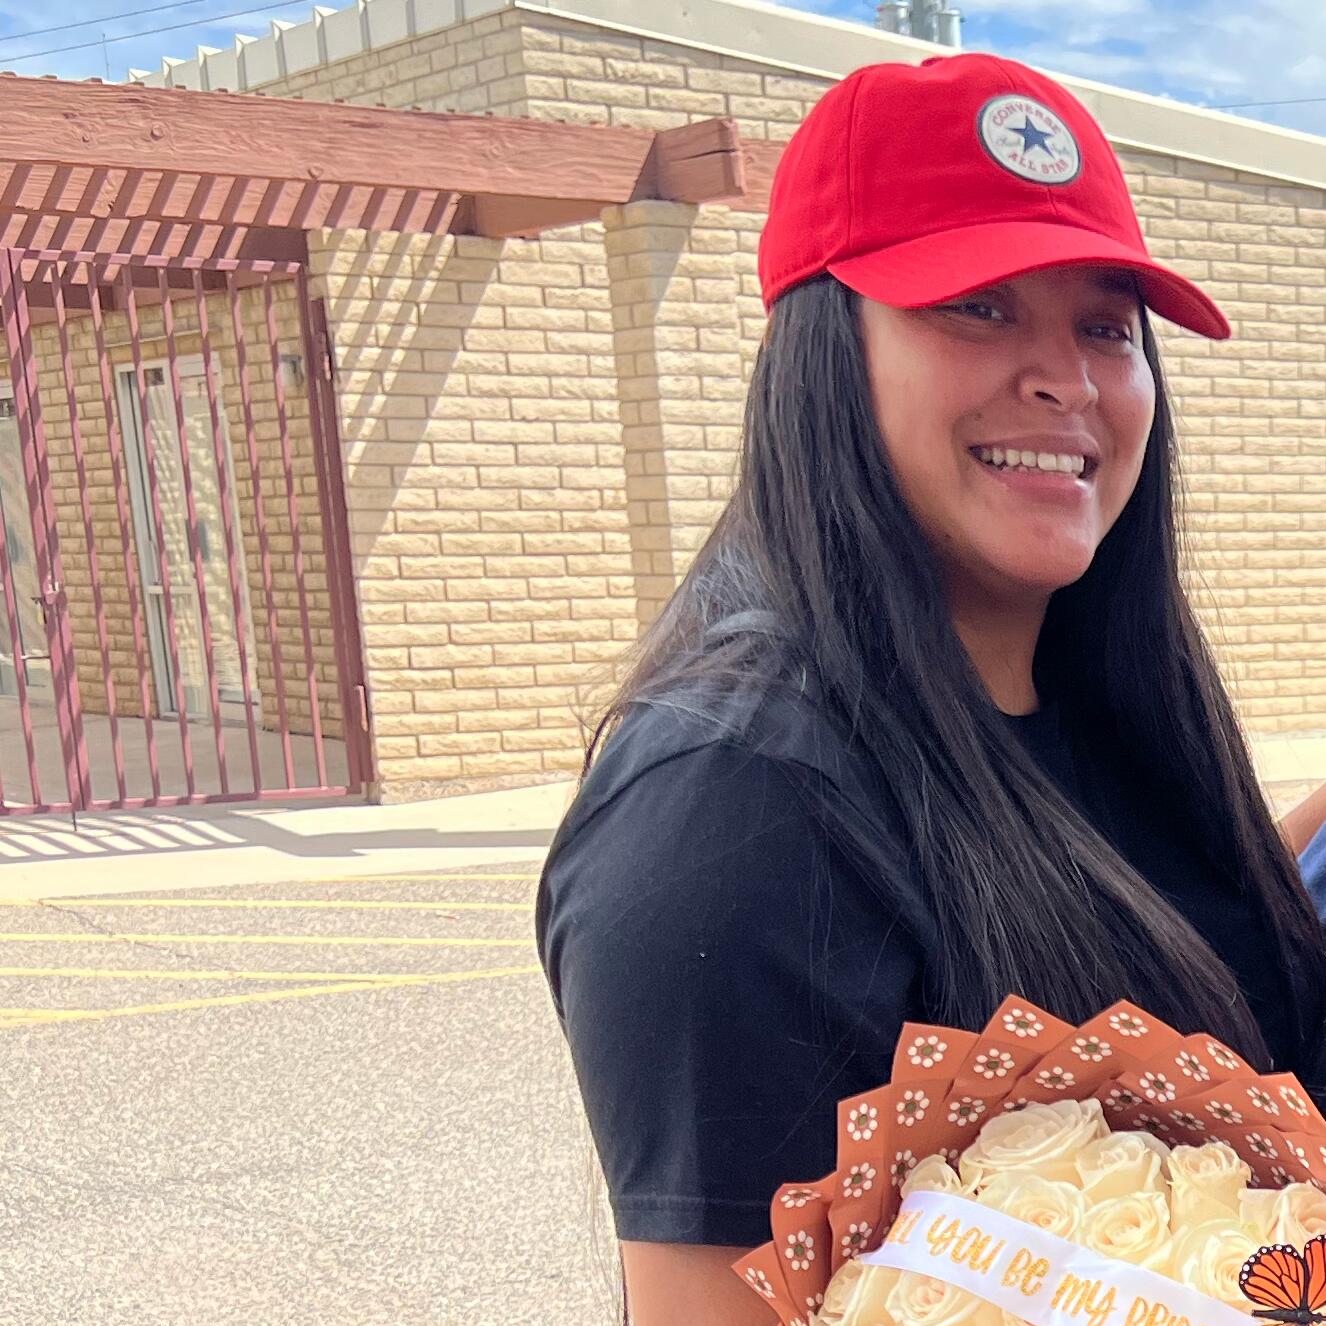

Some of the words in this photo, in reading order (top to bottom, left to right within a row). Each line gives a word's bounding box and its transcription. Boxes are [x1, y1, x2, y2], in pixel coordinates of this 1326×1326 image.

[992, 102, 1062, 133] CONVERSE
[1008, 151, 1037, 172] ALL
[1041, 158, 1069, 175] STAR
